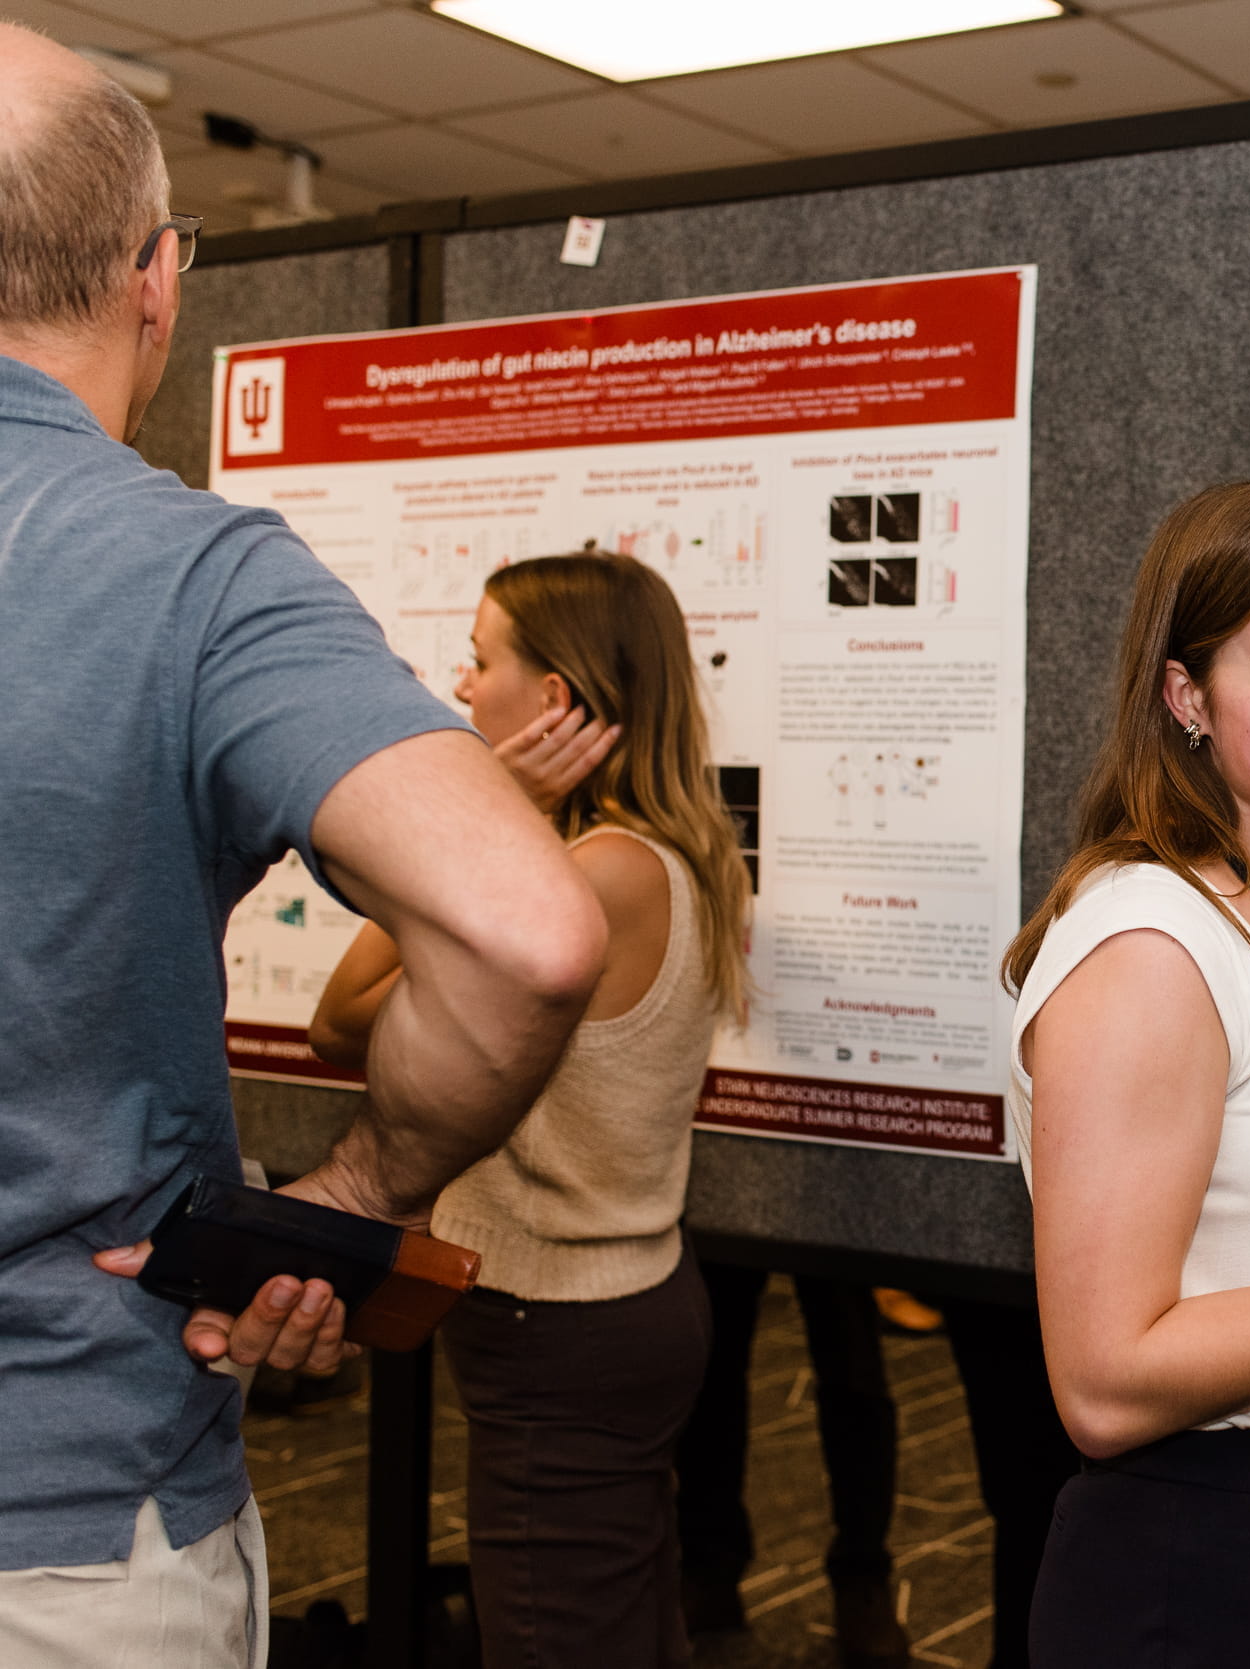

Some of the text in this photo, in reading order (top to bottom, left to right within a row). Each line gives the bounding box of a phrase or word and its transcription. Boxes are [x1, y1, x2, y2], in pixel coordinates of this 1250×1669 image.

[482, 353, 501, 376] of
[502, 350, 533, 379] gut
[534, 344, 589, 371] niacin
[592, 337, 692, 370] production
[695, 334, 713, 357] in
[716, 323, 833, 355] Alzheimer's
[836, 316, 917, 343] disease
[848, 638, 924, 653] Conclusions
[842, 893, 918, 910] Future Work
[823, 997, 936, 1019] Acknowledgments
[853, 1088, 919, 1111] RESEARCH
[803, 1107, 856, 1128] SUMMER
[857, 1113, 922, 1135] RESEARCH
[925, 1120, 993, 1142] PROGRAM
